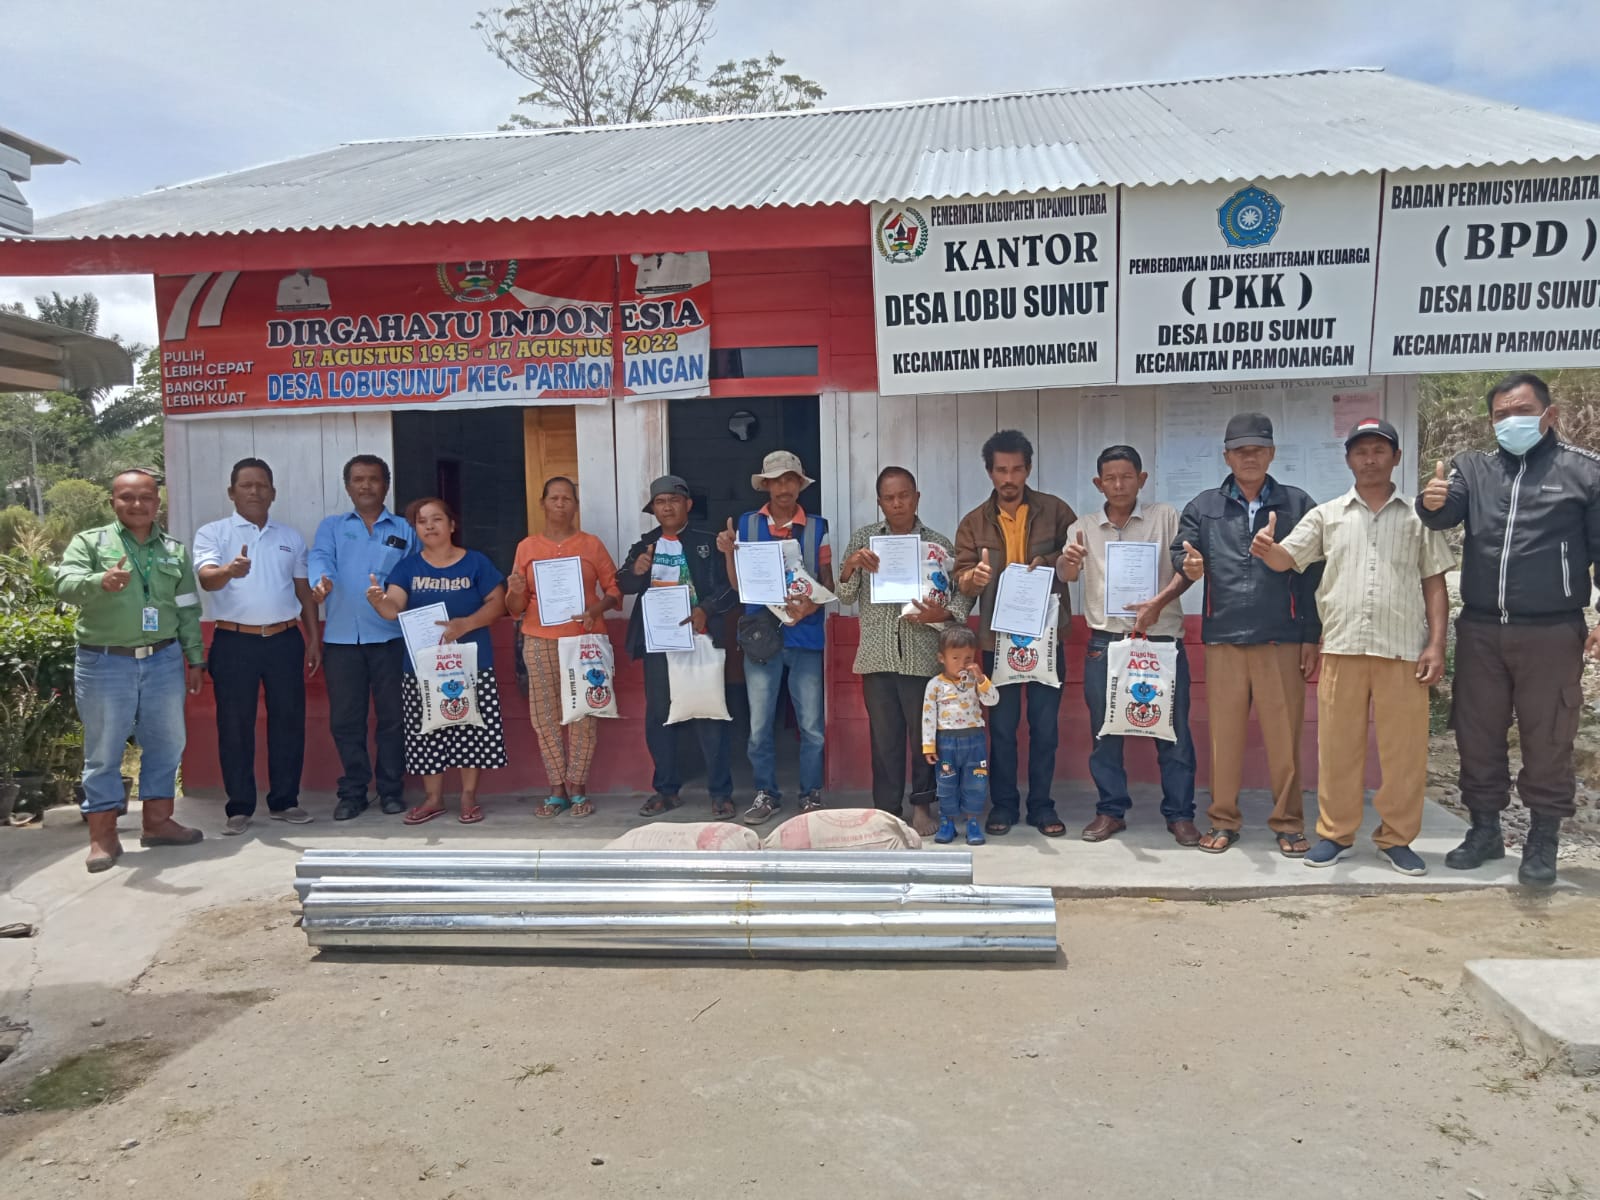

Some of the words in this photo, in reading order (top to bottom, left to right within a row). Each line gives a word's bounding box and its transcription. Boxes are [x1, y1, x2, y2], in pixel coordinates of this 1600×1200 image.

[1391, 183, 1445, 209] BADAN
[1447, 175, 1600, 207] PERMUSYAWARATA
[931, 203, 984, 227] PEMERINTAH
[985, 199, 1035, 223] KABUPATEN
[1035, 195, 1077, 219] TAPANULI
[1078, 193, 1107, 216] UTARA
[944, 231, 1098, 272] KANTOR
[1464, 220, 1568, 260] BPD
[1129, 255, 1208, 275] PEMBERDAYAAN
[1210, 254, 1231, 270] DAN
[1233, 249, 1315, 270] KESEJAHTERAAN
[1316, 247, 1370, 266] KELUARGA
[885, 291, 948, 327] DESA
[953, 286, 1017, 322] LOBU
[1023, 280, 1109, 318] SUNUT
[1207, 272, 1286, 311] PKK
[1418, 284, 1472, 314] DESA
[1476, 282, 1533, 312] LOBU
[266, 311, 482, 348] DIRGAHAYU
[490, 299, 703, 338] INDONESIA
[1158, 323, 1208, 346] DESA
[1212, 320, 1264, 344] LOBU
[1268, 317, 1337, 342] SUNUT
[163, 350, 205, 363] PULIH
[292, 349, 315, 369] 17
[319, 345, 414, 367] AGUSTUS
[420, 343, 469, 363] 1945
[488, 341, 510, 360] 17
[516, 337, 613, 358] AGUSTUS
[625, 332, 678, 355] 2022
[893, 348, 980, 375] KECAMATAN
[983, 341, 1098, 369] PARMONANGAN
[1392, 332, 1493, 356] KECAMATAN
[164, 364, 203, 378] LEBIH
[206, 361, 254, 375] CEPAT
[1135, 350, 1228, 374] KECAMATAN
[1232, 345, 1355, 370] PARMONANGAN
[165, 379, 227, 394] BANGKIT
[267, 371, 323, 401] DESA
[327, 368, 461, 398] LOBUSUNUT
[467, 364, 517, 392] KEC.
[166, 394, 205, 408] LEBIH
[208, 392, 246, 405] KUAT
[412, 576, 471, 591] Mango
[435, 660, 463, 671] ACC
[1127, 658, 1161, 672] ACC
